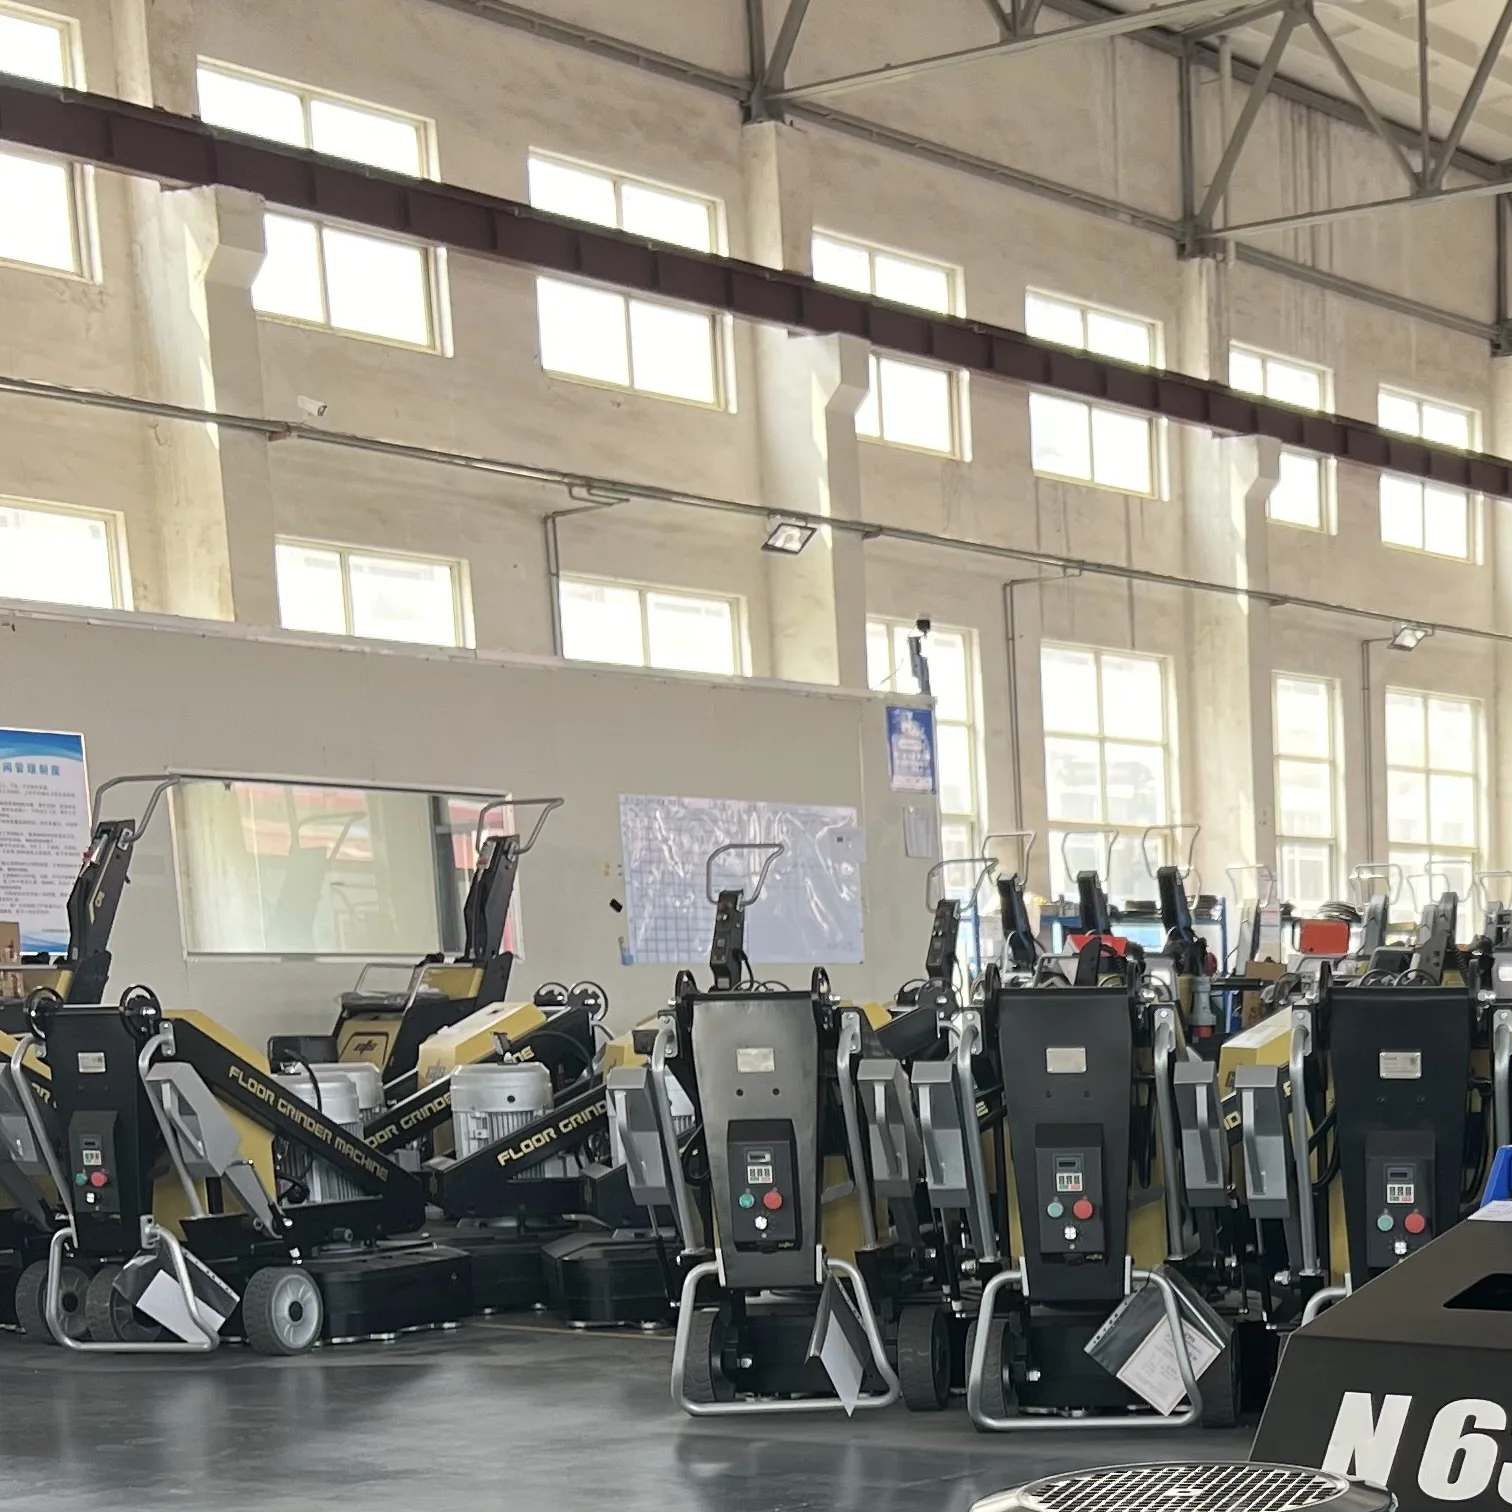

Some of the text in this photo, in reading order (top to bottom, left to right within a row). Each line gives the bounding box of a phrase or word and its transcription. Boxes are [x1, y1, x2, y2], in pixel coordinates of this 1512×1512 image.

[228, 1066, 389, 1182] FLOOR GRINDER MACHINE
[365, 1092, 451, 1148] OOR GRINDE
[497, 1100, 607, 1166] FLOOR GRIND
[1322, 1391, 1413, 1490] N
